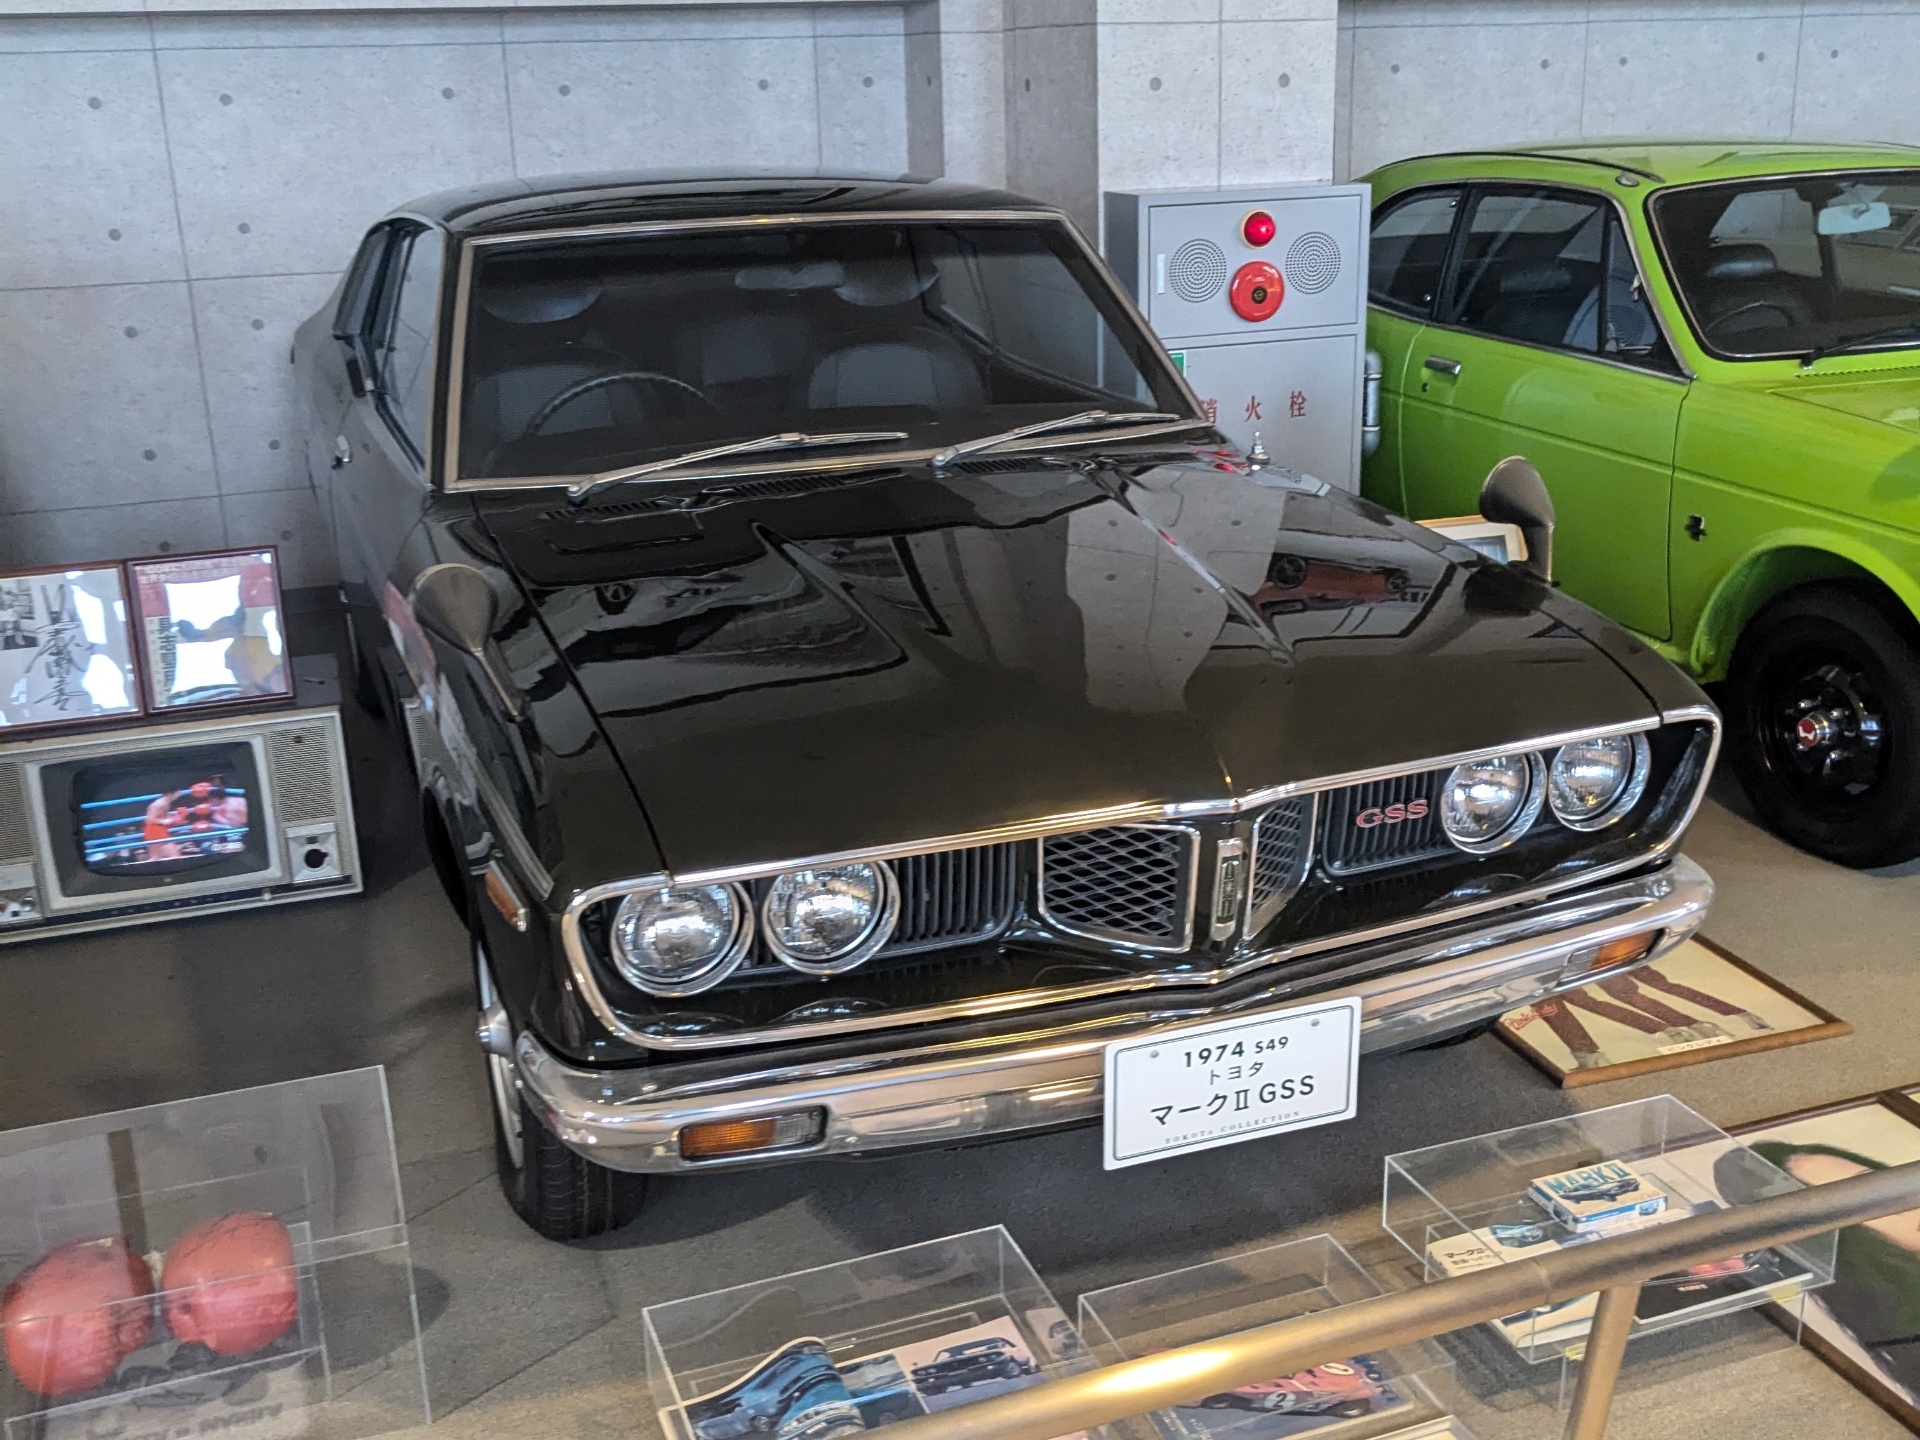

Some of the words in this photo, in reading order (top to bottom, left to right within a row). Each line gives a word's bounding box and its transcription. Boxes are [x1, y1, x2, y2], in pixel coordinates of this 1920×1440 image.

[1356, 799, 1429, 829] GSS
[1184, 1042, 1244, 1068] 1974
[1255, 1036, 1289, 1054] S49
[1210, 1061, 1264, 1085] トヨタ
[1259, 1075, 1315, 1104] GSS
[1165, 1129, 1214, 1144] YOKOTA
[1220, 1111, 1300, 1133] COLLECTION
